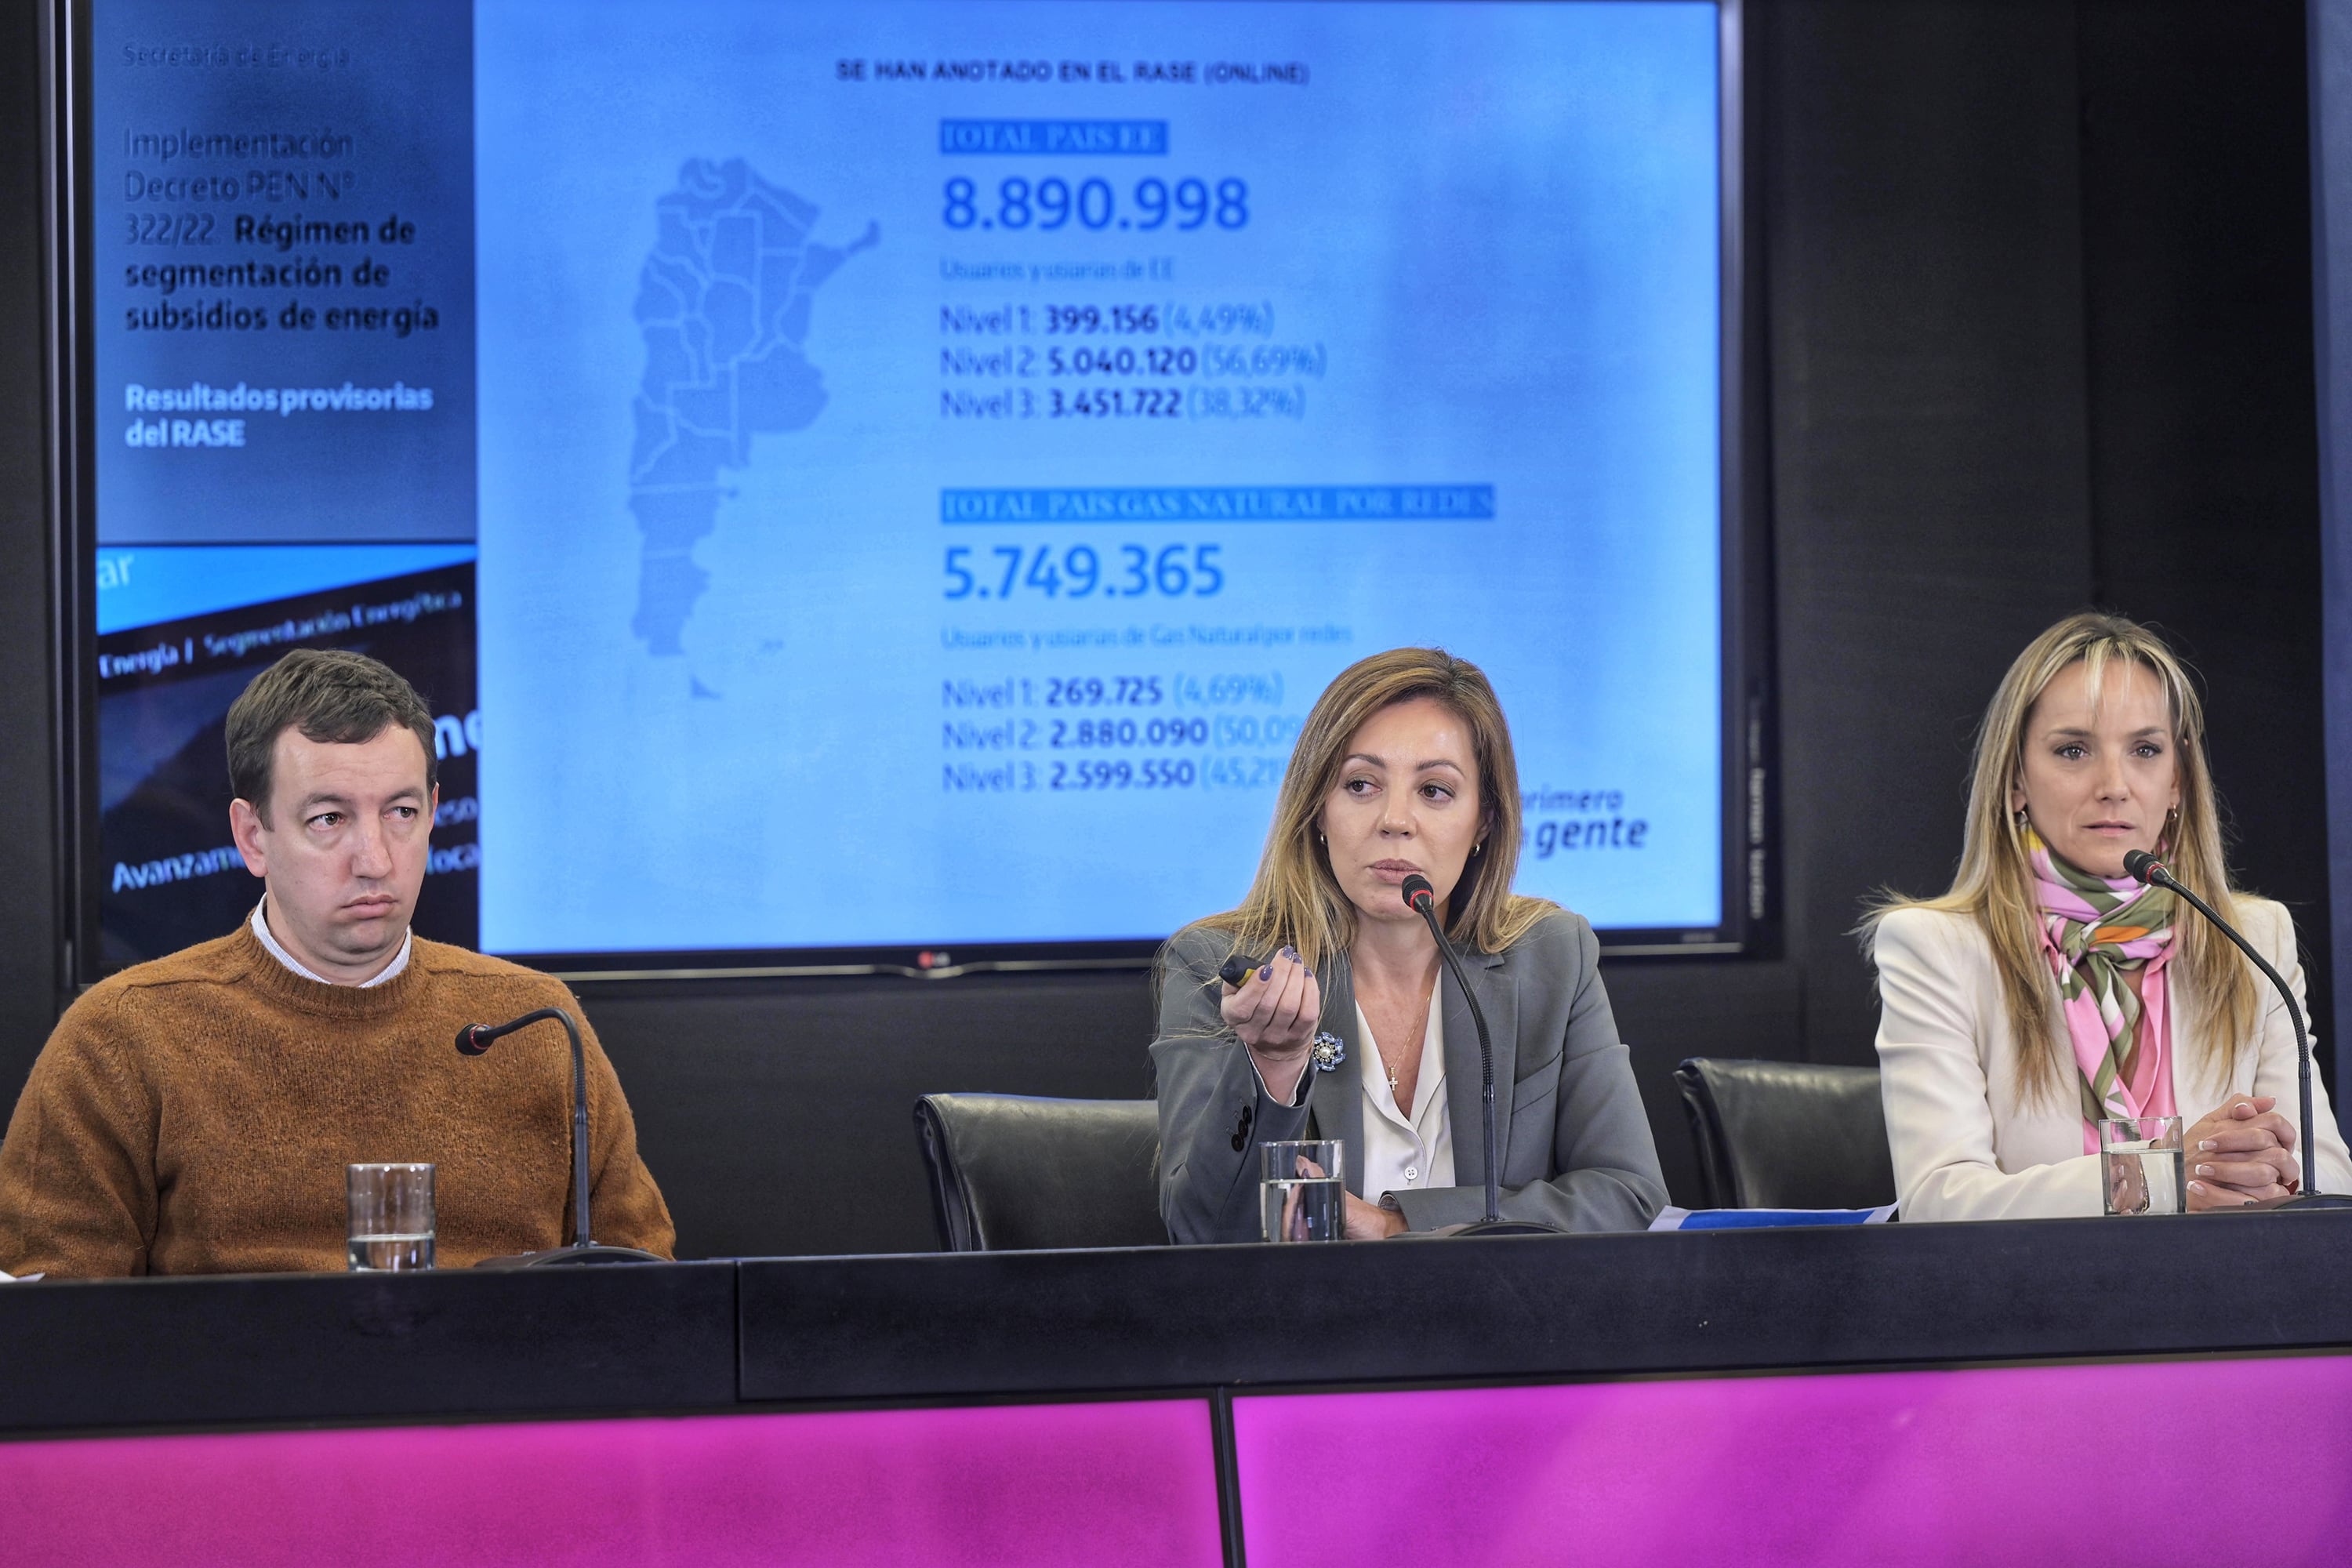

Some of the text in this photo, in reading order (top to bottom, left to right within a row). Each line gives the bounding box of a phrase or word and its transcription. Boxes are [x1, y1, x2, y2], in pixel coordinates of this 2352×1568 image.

[836, 60, 1310, 86] SE HAN ANOTADO EN EL RASE (ONLINE)
[125, 128, 353, 162] Implementación
[125, 170, 238, 202] Decreto
[245, 170, 309, 201] PEN
[943, 177, 1250, 230] 8.890.998
[236, 214, 368, 252] Régimen
[378, 216, 416, 245] de
[125, 257, 390, 294] segmentación de
[125, 299, 439, 339] subsidios de energía
[941, 303, 1014, 333] Nivel
[1045, 303, 1160, 336] 399.156
[1163, 299, 1274, 340] (4,49%)
[941, 345, 1014, 376] Nivel
[1048, 346, 1198, 377] 5.040.120
[1201, 342, 1328, 382] (56,69%)
[125, 382, 434, 417] Resultados provisorias
[941, 387, 1014, 419] Nivel
[1047, 387, 1184, 419] 3.451.722
[1185, 383, 1307, 423] (38,32%)
[125, 418, 245, 448] del RASE
[1120, 490, 1182, 517] GAS
[1187, 488, 1323, 517] NATURAL
[944, 543, 1225, 601] 5.749.365
[942, 677, 1014, 709] Nivel
[1045, 677, 1163, 708] 269.725
[1172, 672, 1285, 710] (4,69%)
[942, 719, 1014, 750] Nivel
[1048, 718, 1208, 750] 2.880.090
[1213, 715, 1305, 754] (50,09
[942, 760, 1014, 792] Nivel
[1048, 760, 1196, 790] 2.599.550
[1200, 756, 1287, 797] (45,21
[1535, 819, 1649, 859] gente
